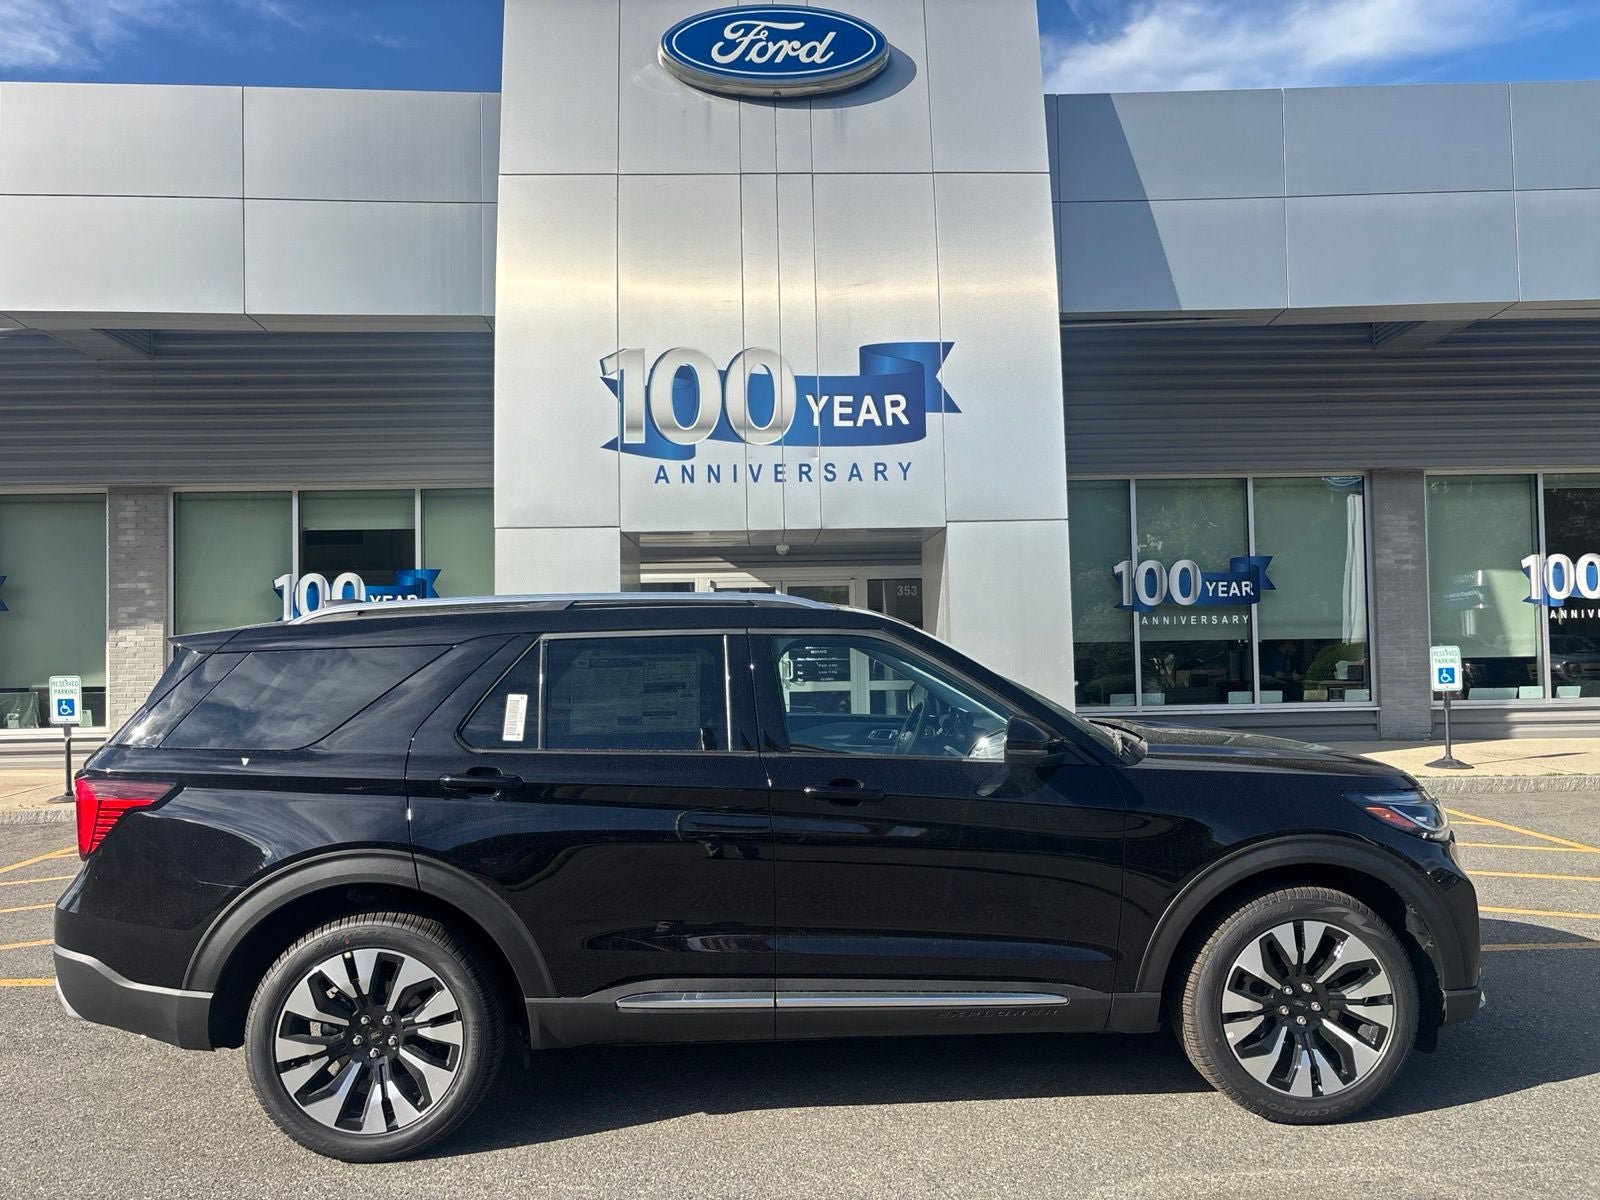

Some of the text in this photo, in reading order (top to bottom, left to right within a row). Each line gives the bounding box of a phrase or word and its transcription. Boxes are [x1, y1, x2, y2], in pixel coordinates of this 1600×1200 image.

[711, 20, 837, 64] Ford
[599, 347, 910, 445] 100 YEAR
[654, 462, 912, 484] ANNIVERSARY
[272, 572, 366, 621] 100
[896, 585, 918, 596] 353
[1112, 560, 1254, 606] 100 YEAR
[1521, 553, 1600, 600] 100
[1142, 615, 1249, 625] ANNIVERSARY
